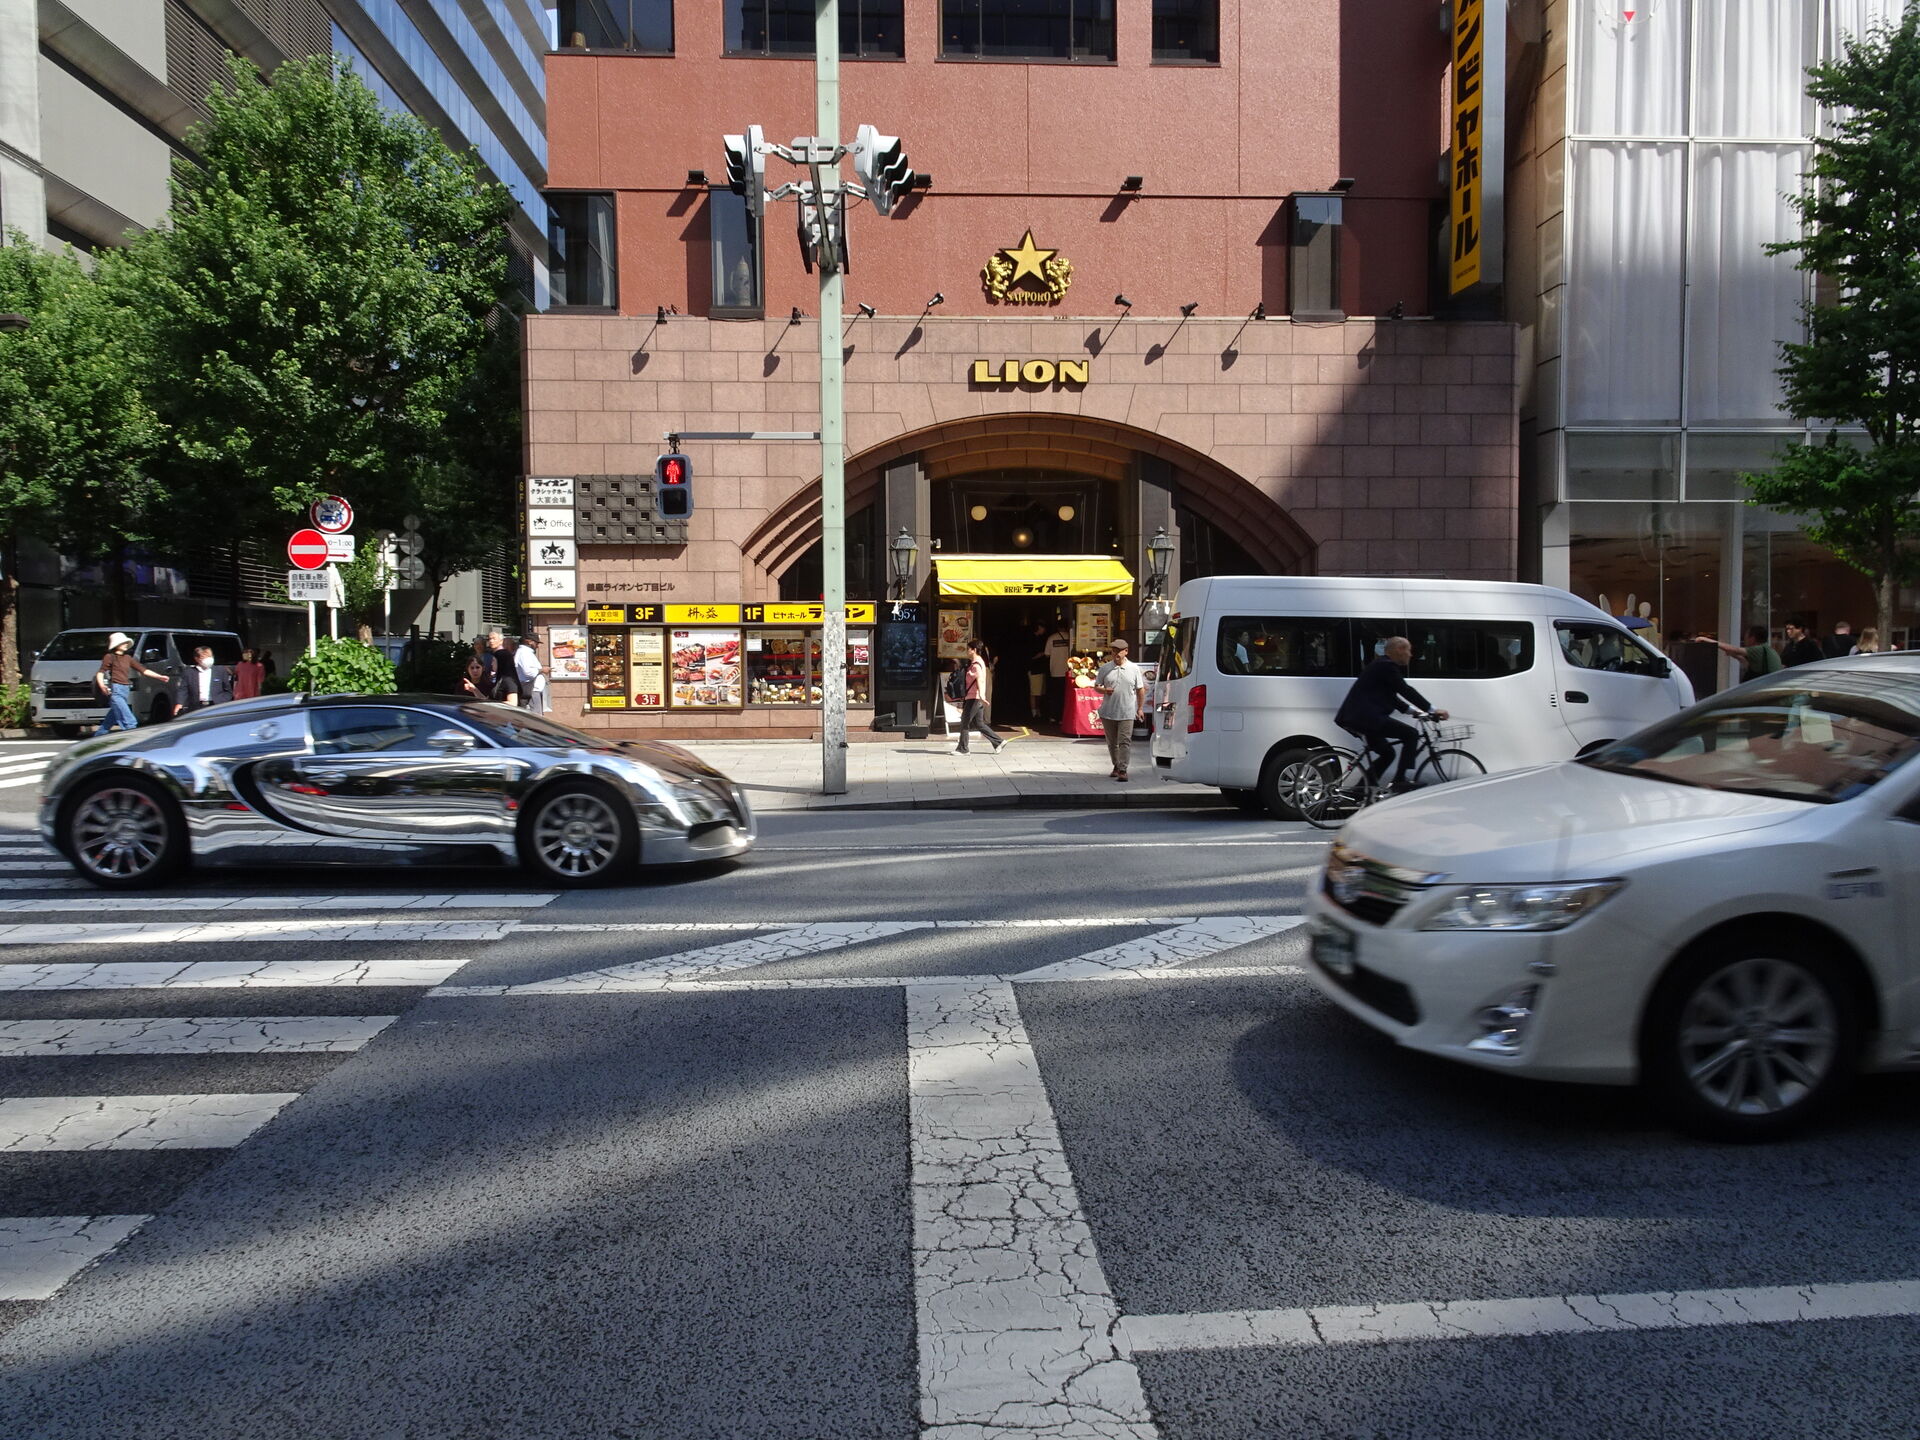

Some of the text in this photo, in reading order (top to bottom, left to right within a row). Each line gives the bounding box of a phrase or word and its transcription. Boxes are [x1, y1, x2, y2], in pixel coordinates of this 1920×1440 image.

[1006, 291, 1051, 302] SAPPORO
[974, 360, 1089, 383] LION
[536, 496, 567, 504] 大宴会場
[550, 519, 572, 528] Office
[586, 583, 676, 592] 銀座ライオン七丁目ビル
[1004, 584, 1069, 593] 銀座ライオン
[635, 607, 655, 620] 3F
[744, 607, 762, 620] 1F
[808, 607, 866, 619] ラン
